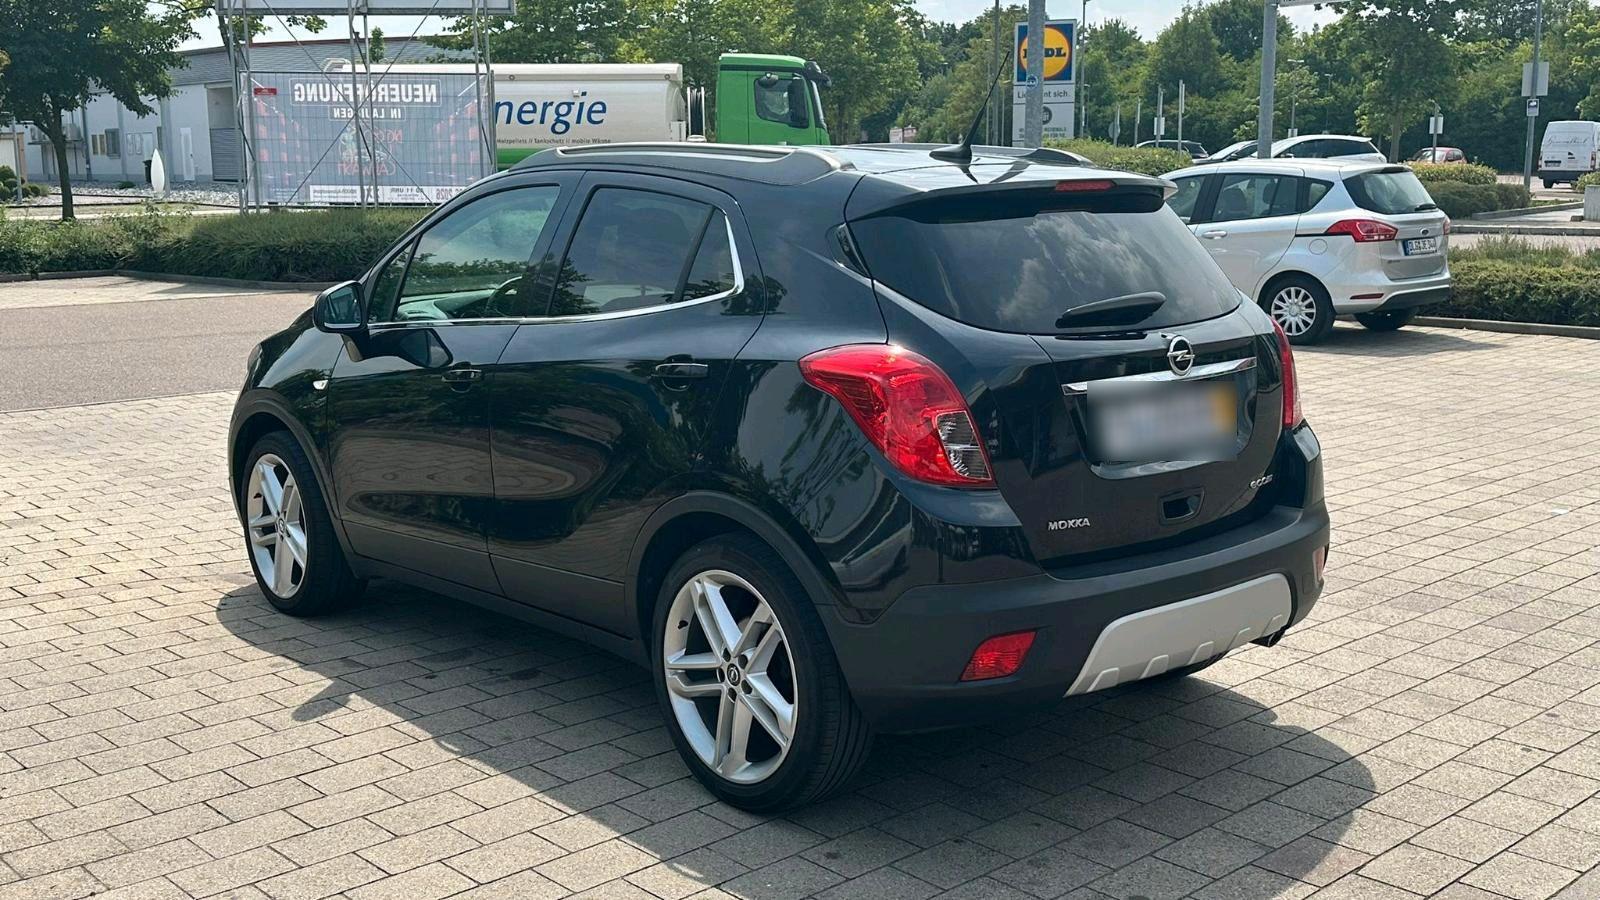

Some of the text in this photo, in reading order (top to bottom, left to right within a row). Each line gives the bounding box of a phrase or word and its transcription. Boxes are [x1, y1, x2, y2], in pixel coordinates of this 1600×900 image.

[1022, 48, 1067, 58] LDL
[495, 91, 607, 135] nergie
[1048, 517, 1090, 530] MOKKA
